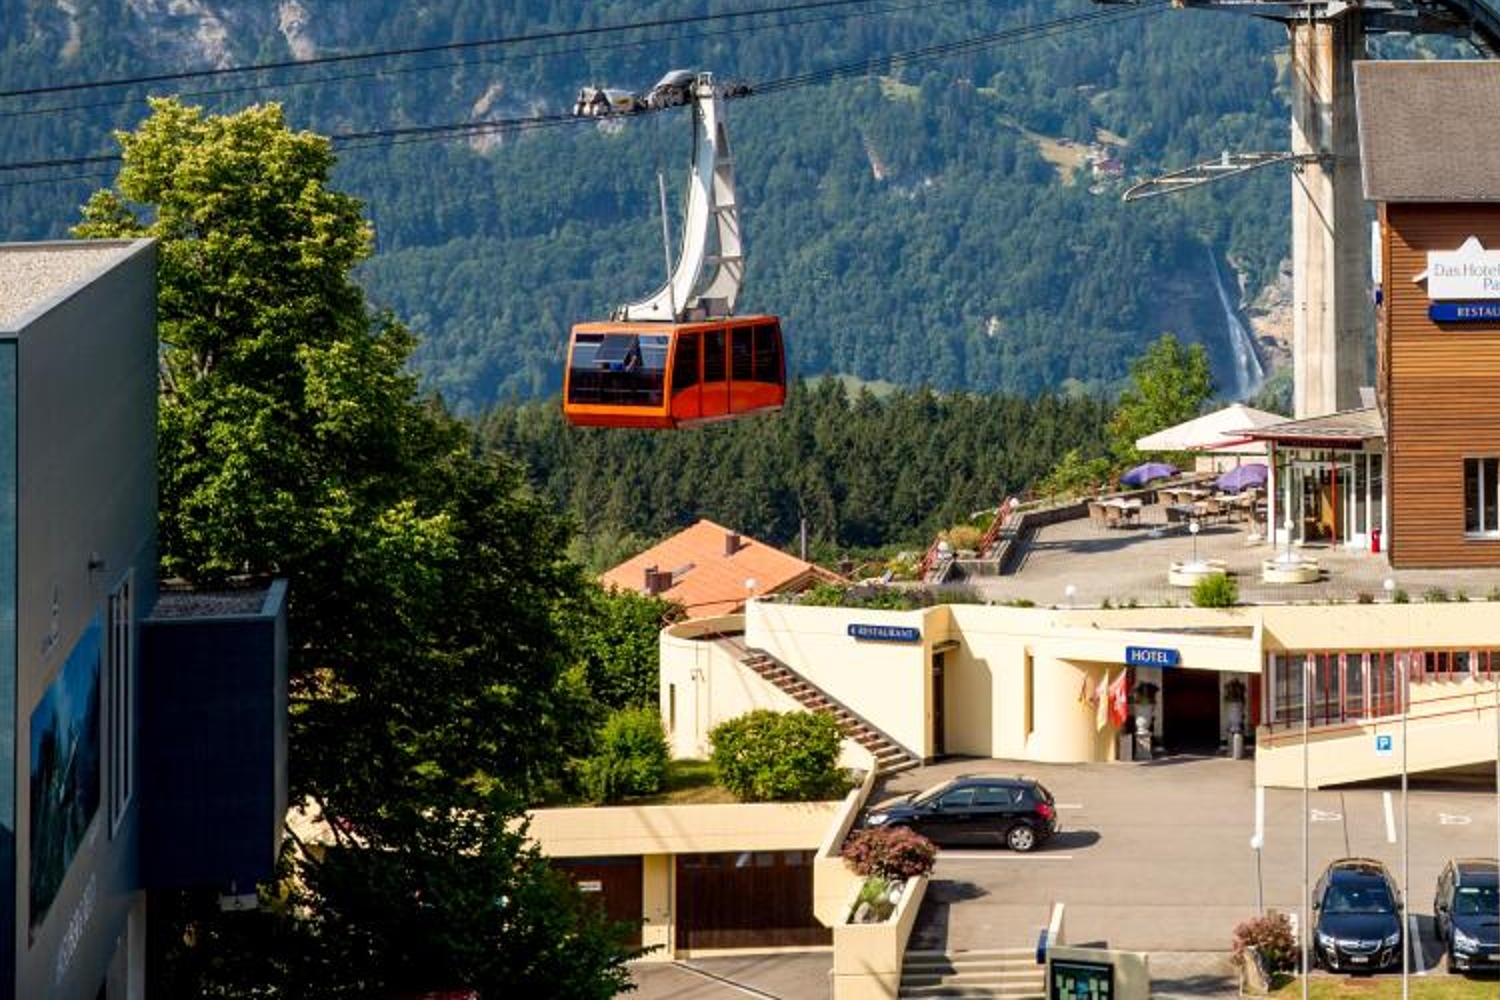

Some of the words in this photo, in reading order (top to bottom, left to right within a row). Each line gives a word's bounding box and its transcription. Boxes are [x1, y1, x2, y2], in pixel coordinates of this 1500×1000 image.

[1434, 263, 1460, 277] Das
[1463, 263, 1500, 277] Hotel
[858, 627, 913, 637] RESTAURANT
[1131, 649, 1169, 662] HOTEL
